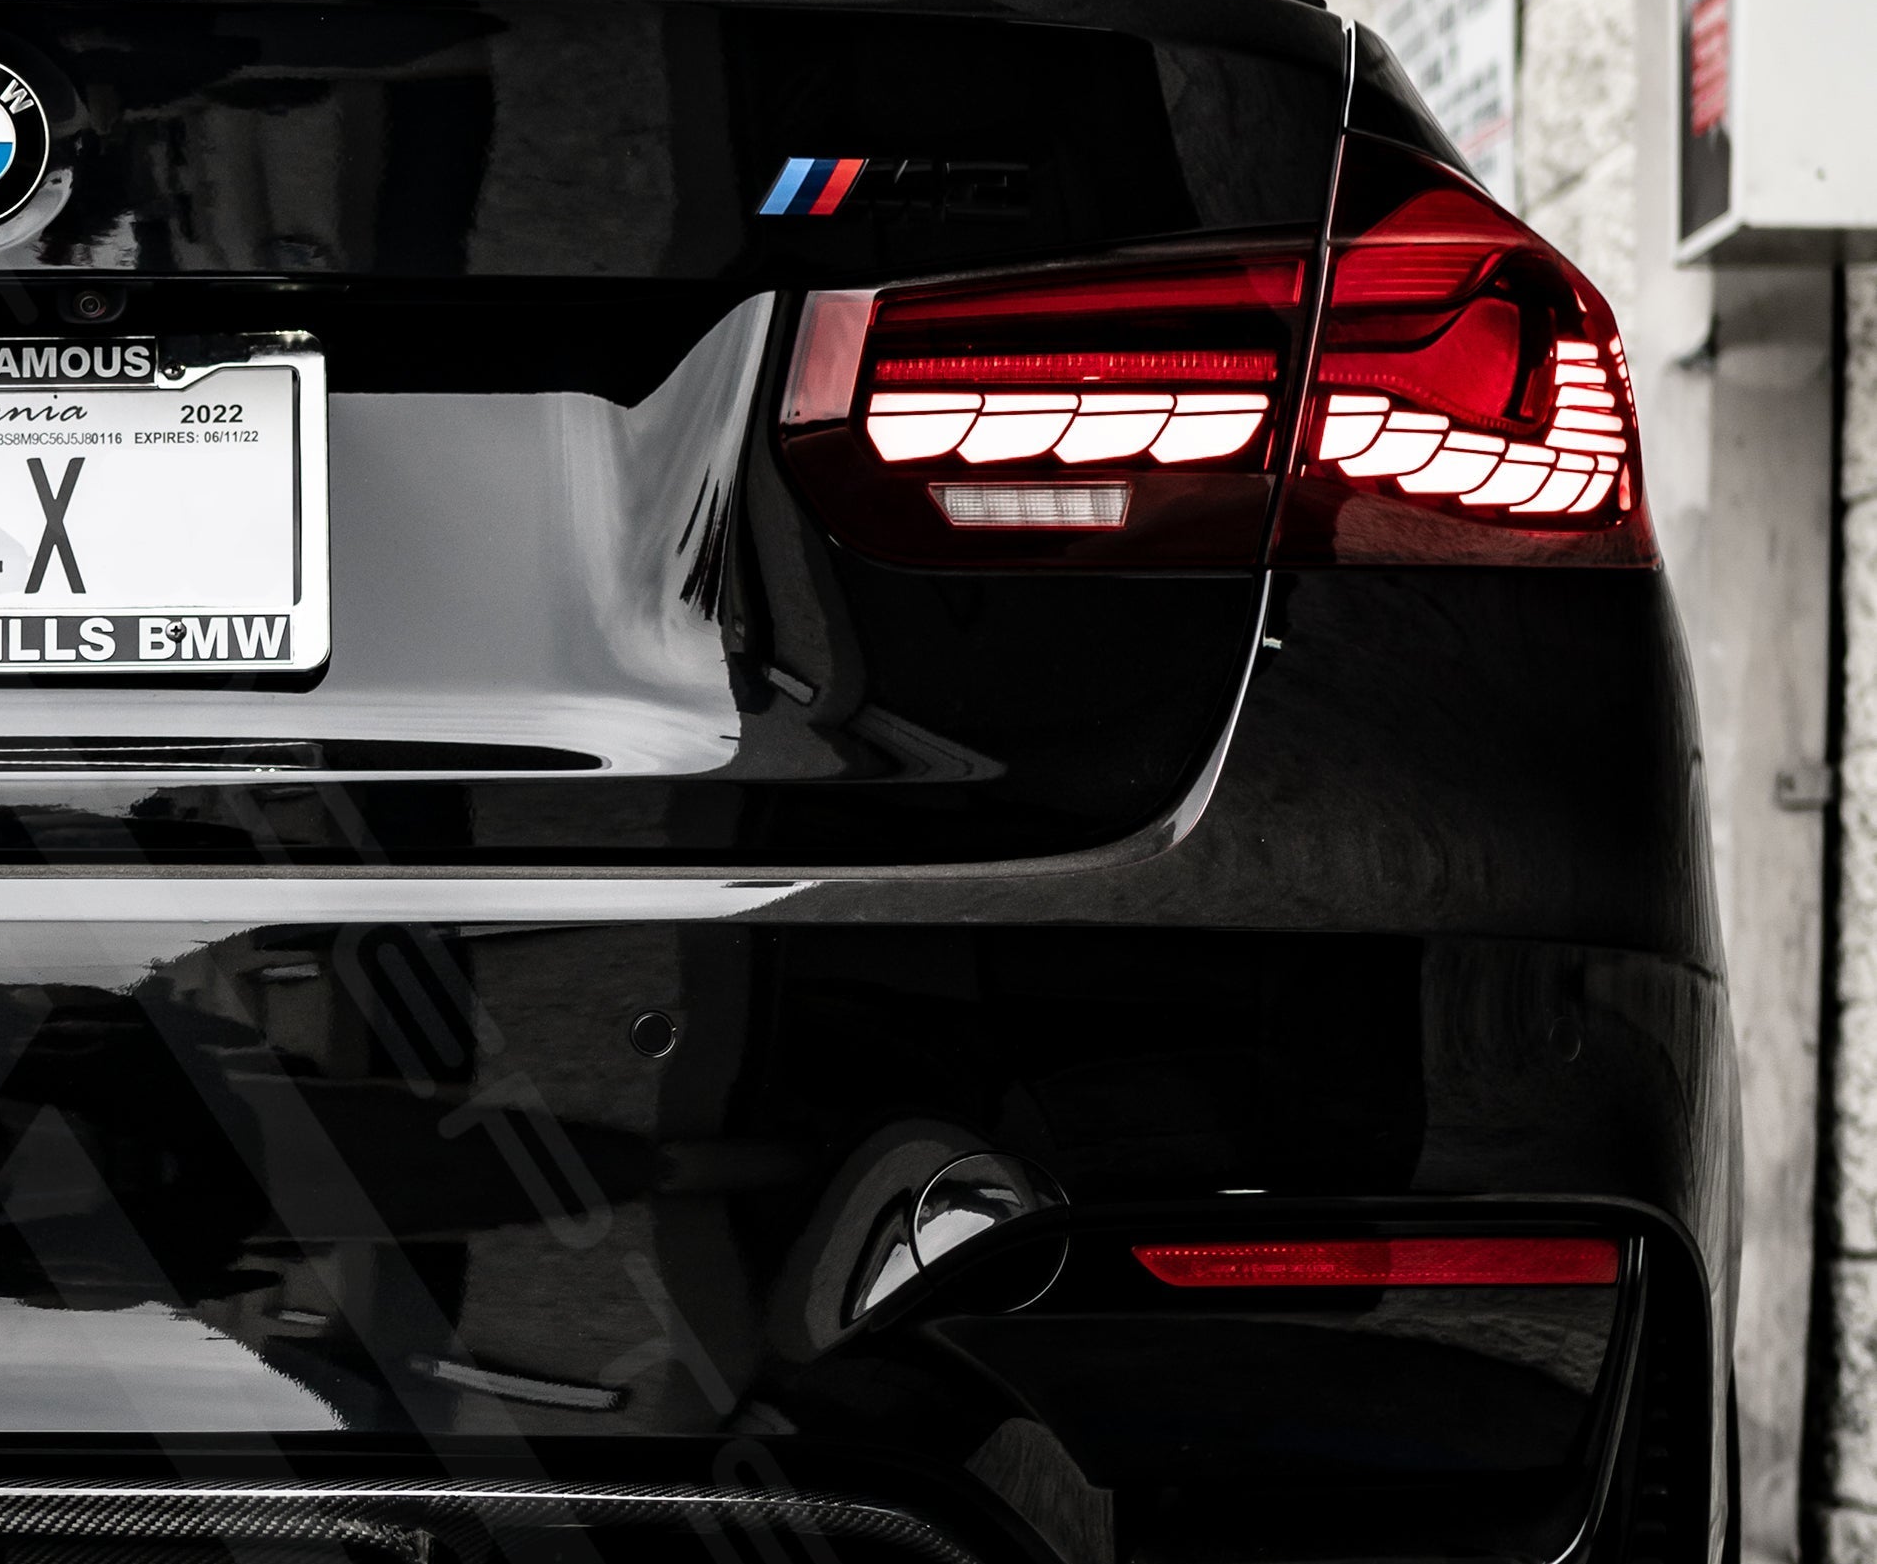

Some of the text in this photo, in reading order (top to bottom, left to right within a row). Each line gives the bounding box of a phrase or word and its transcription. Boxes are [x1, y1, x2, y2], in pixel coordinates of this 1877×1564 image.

[180, 404, 243, 424] 2022
[134, 430, 259, 444] EXPIRES: 06/11/22
[138, 616, 288, 660] BMW
